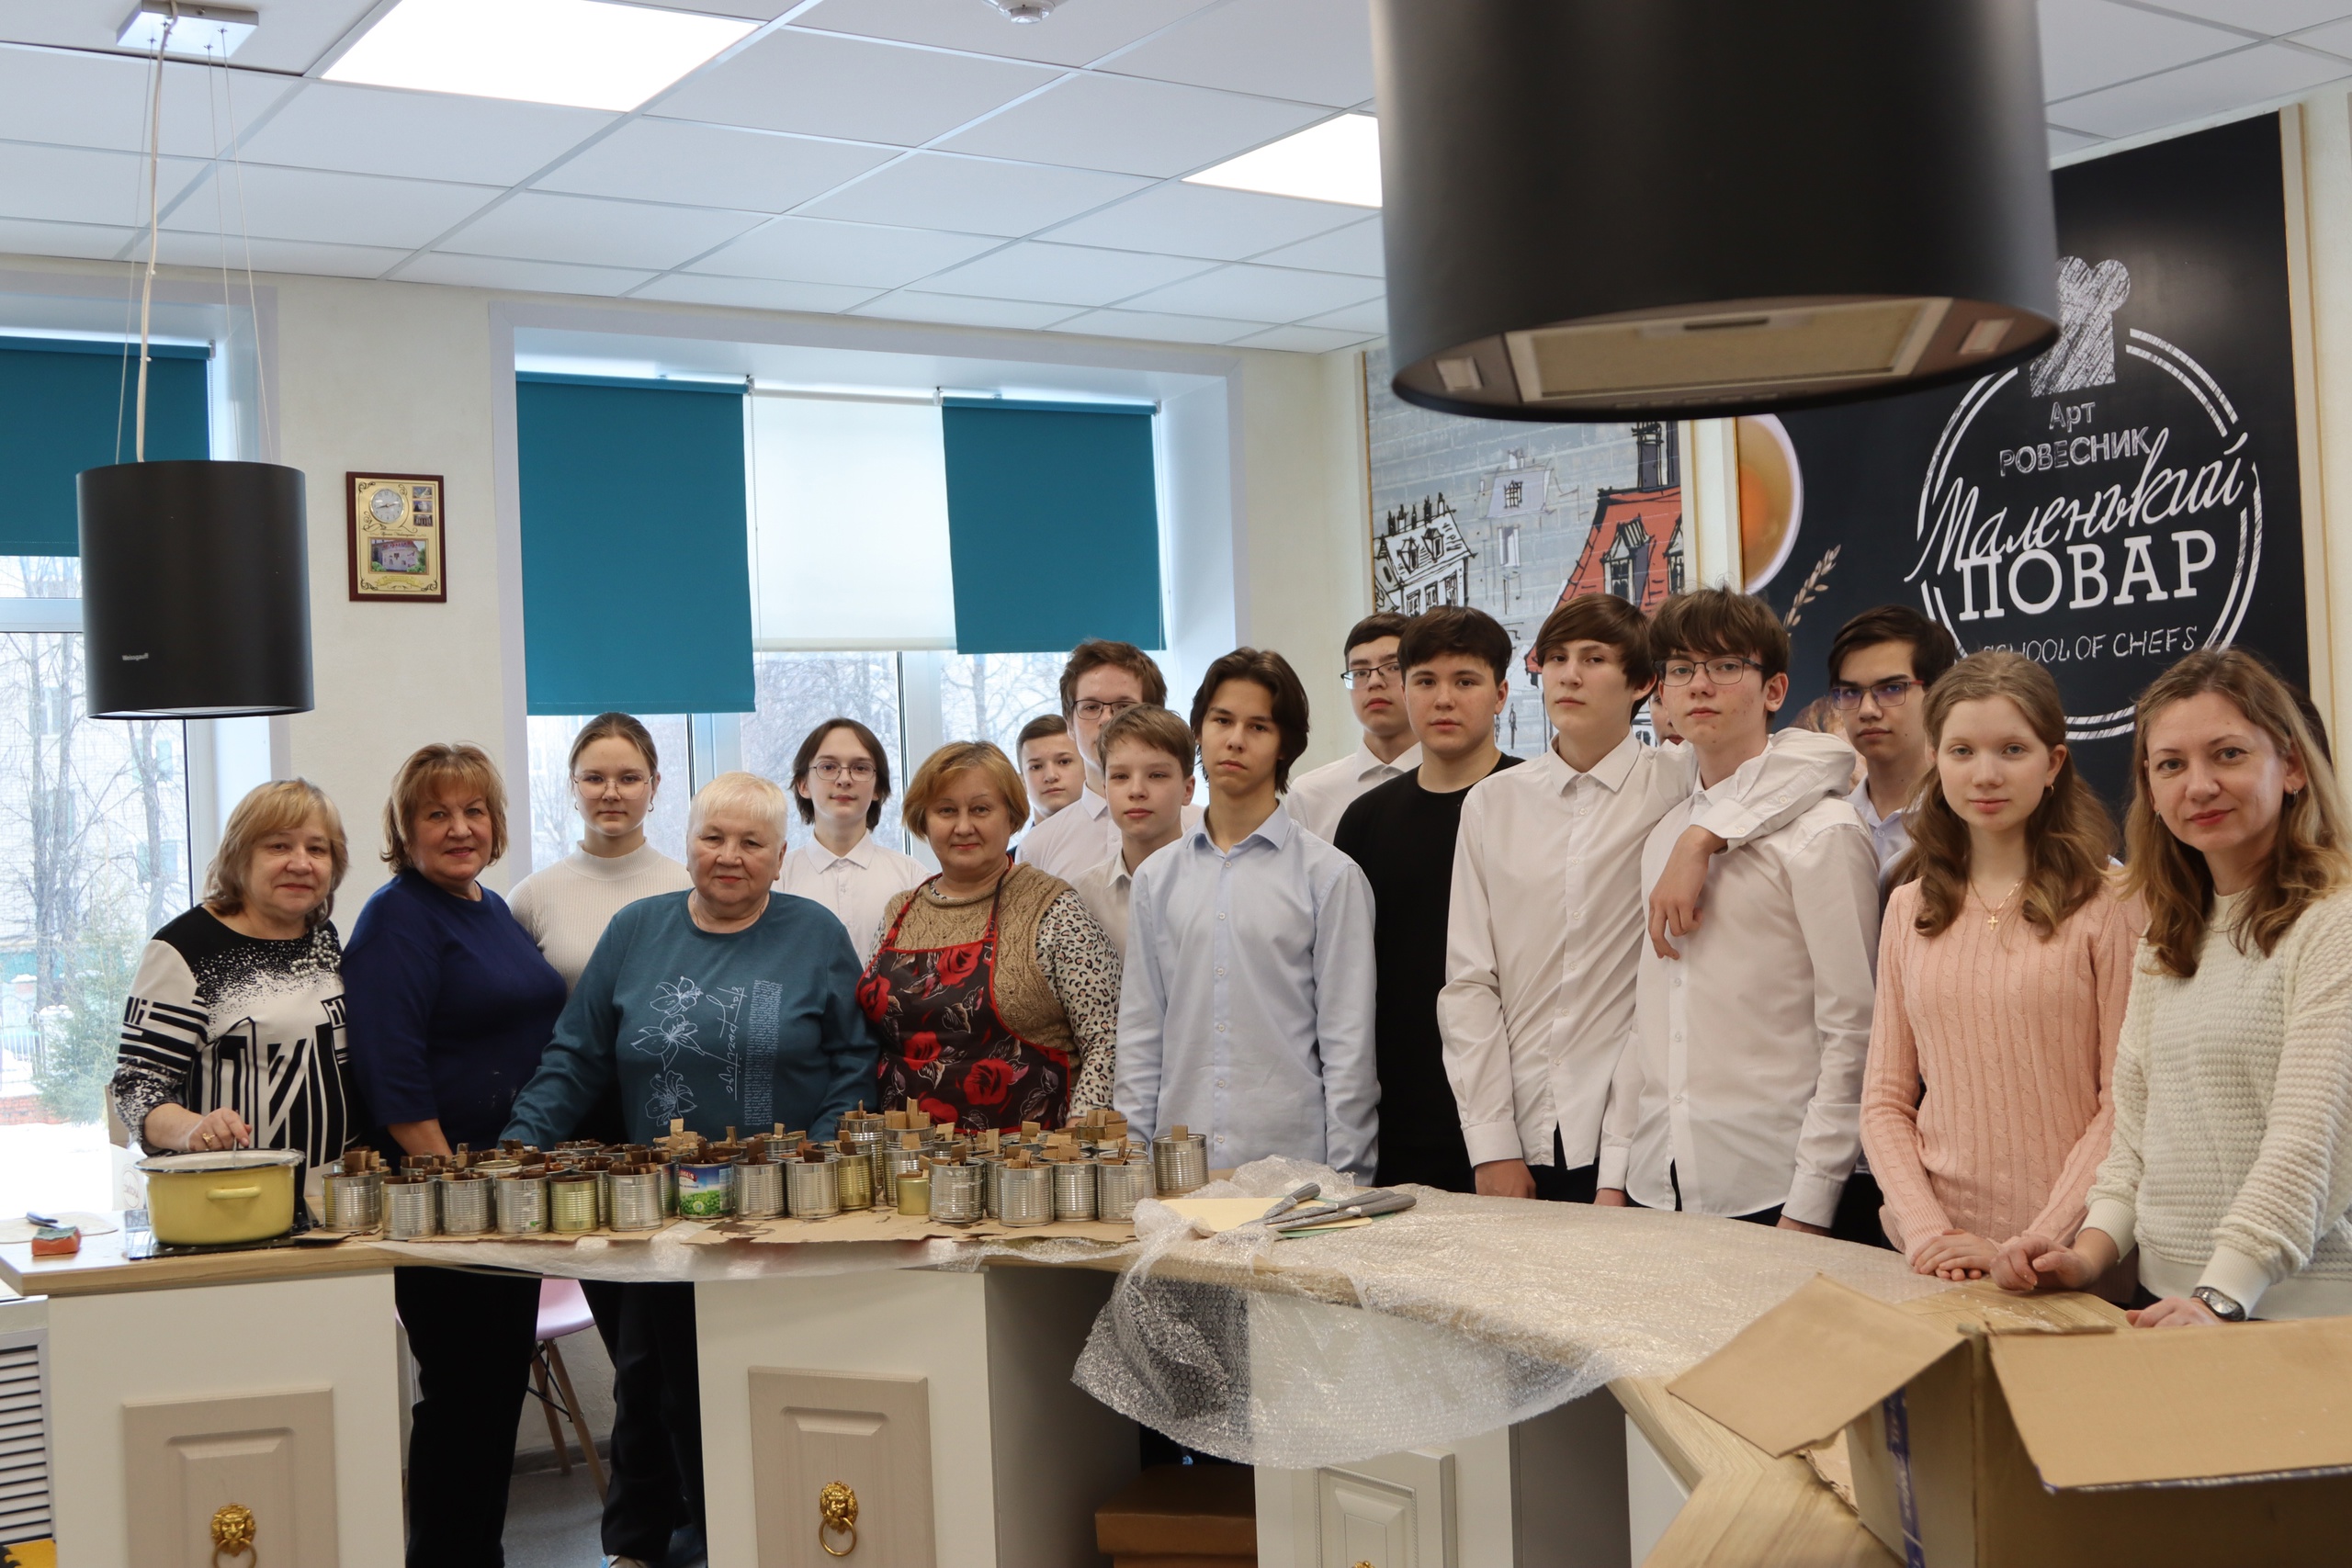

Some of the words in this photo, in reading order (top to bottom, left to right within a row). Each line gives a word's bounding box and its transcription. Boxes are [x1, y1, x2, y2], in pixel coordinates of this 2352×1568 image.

[2049, 401, 2096, 433] Арт
[2000, 426, 2151, 476] РОВЕСНИК
[1904, 427, 2248, 582] Маленький
[1959, 529, 2216, 621] ПОВАР
[2075, 634, 2107, 660] OF
[2113, 626, 2197, 657] CHEFS
